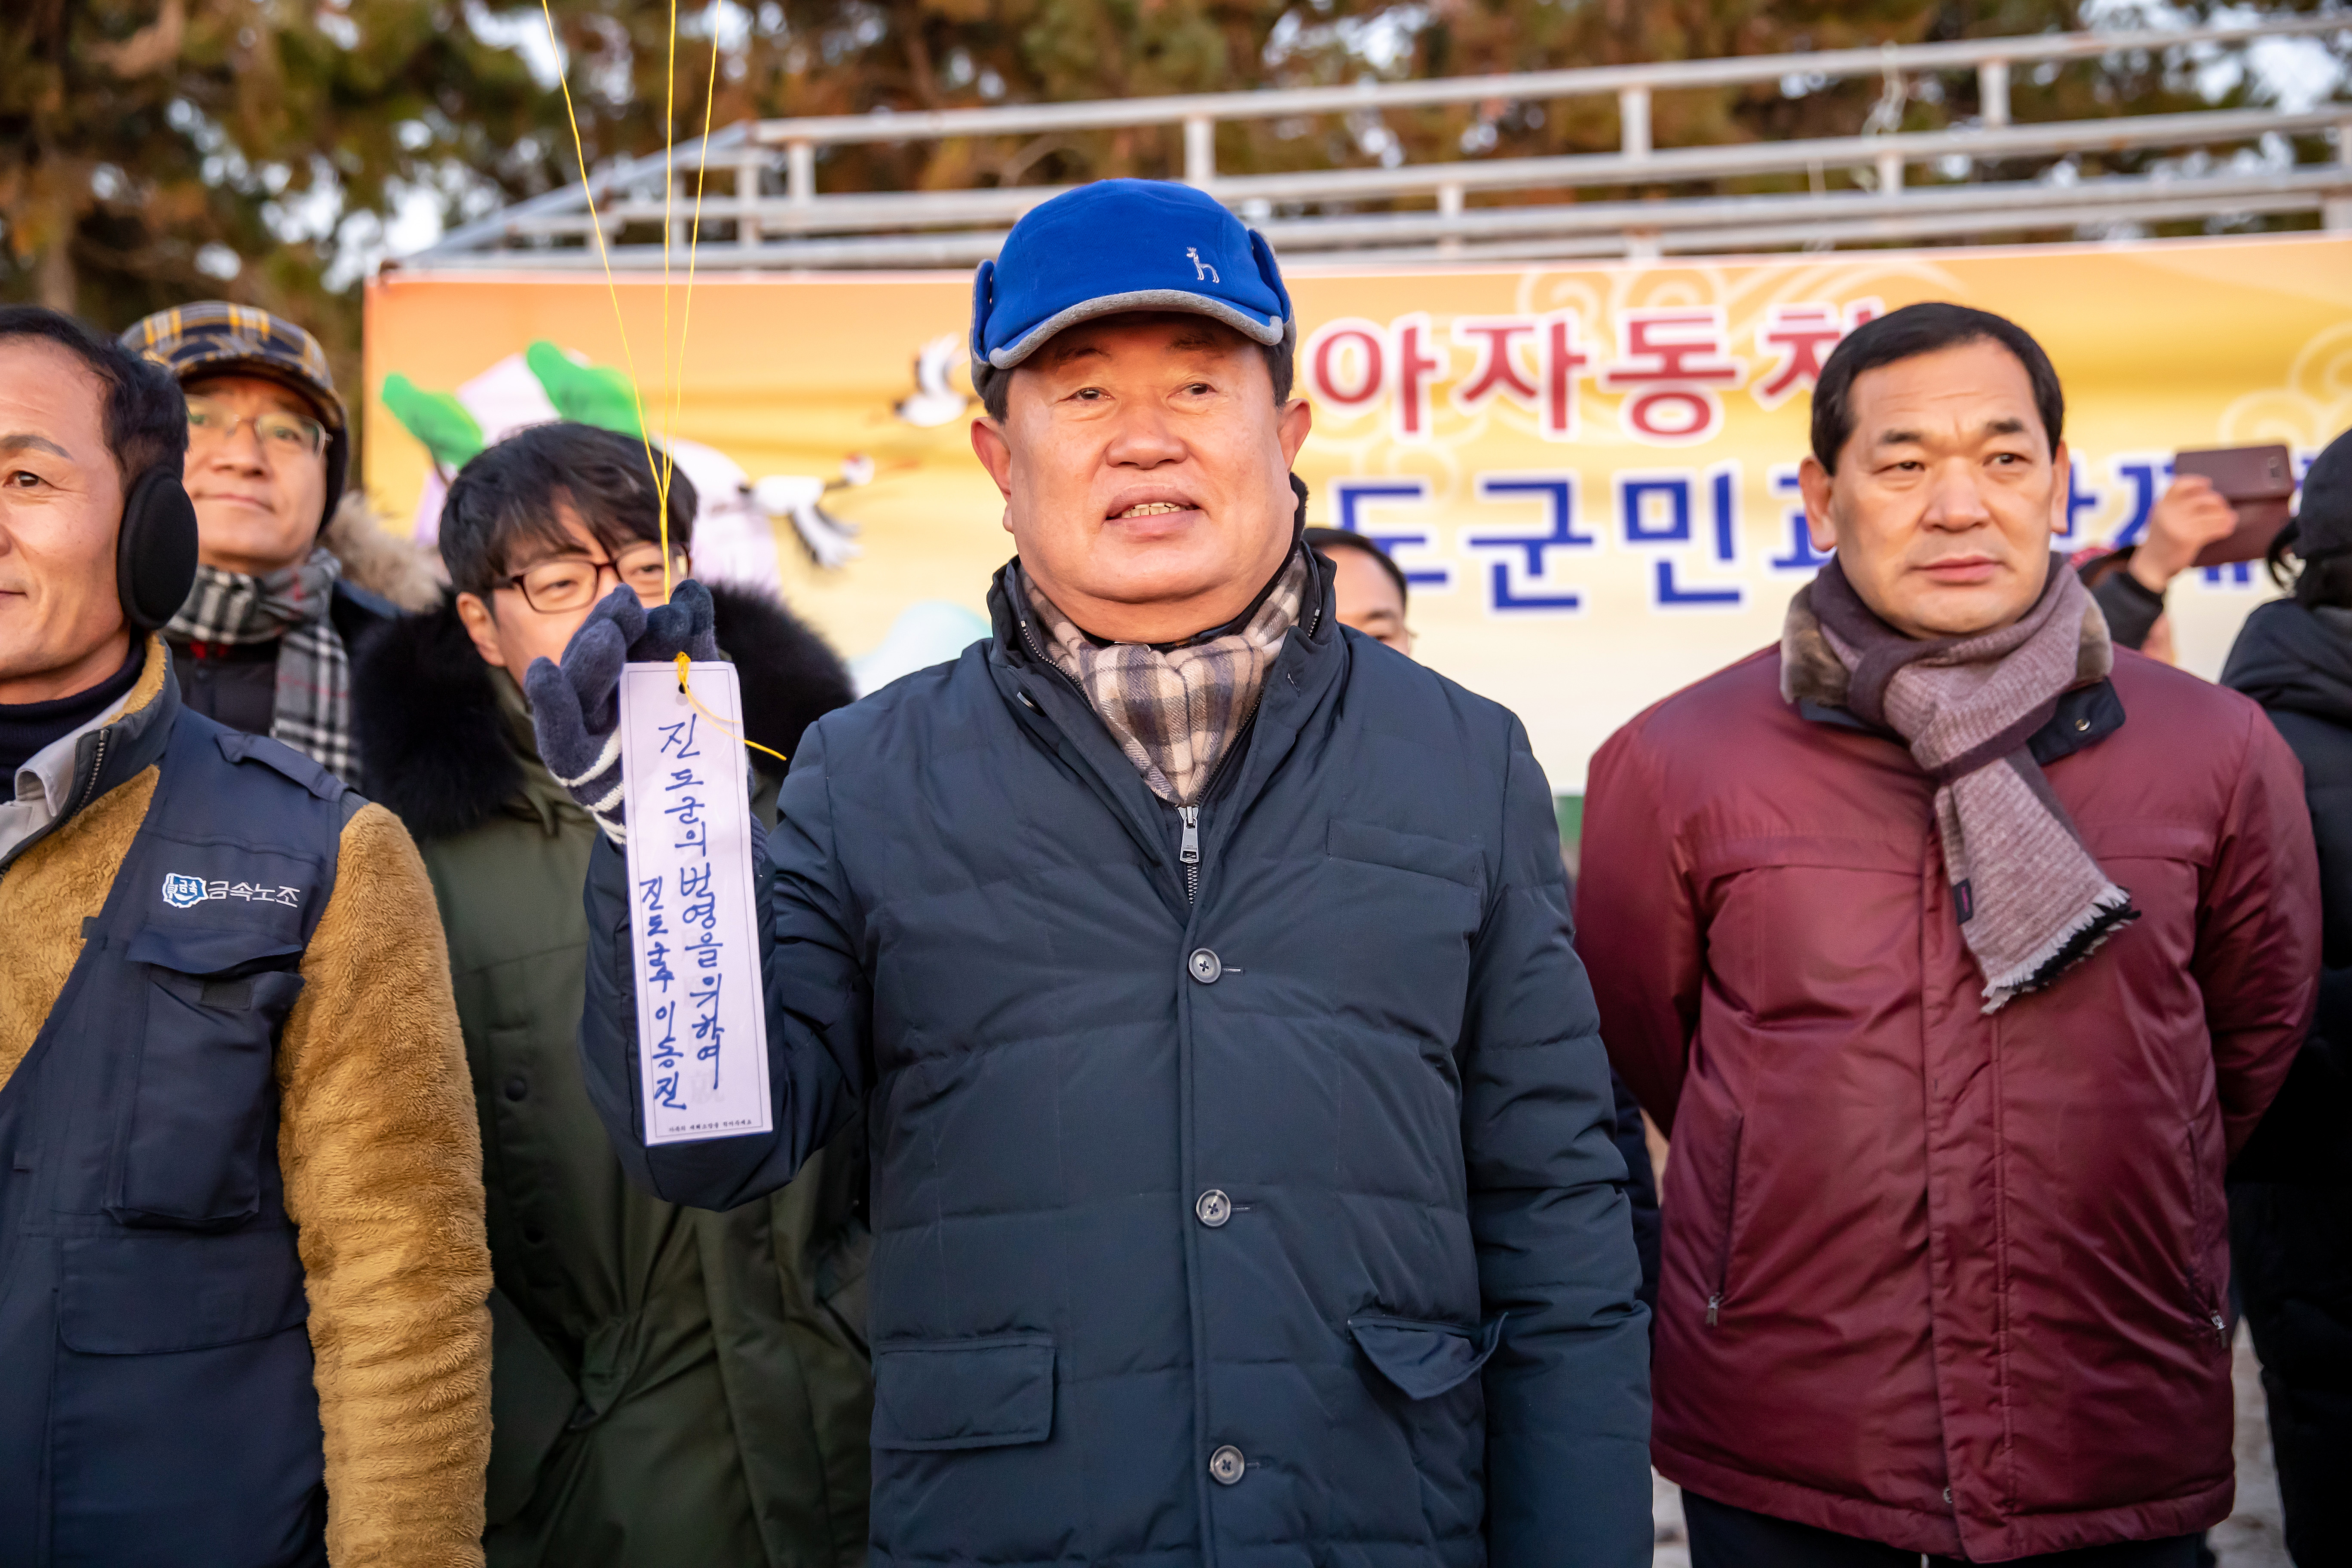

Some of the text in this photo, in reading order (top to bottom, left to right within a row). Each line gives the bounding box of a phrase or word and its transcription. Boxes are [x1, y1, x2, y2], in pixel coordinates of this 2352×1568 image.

[207, 880, 300, 908] 금속노조
[639, 875, 687, 1111] 진도군수 이동진
[658, 712, 725, 1090] 진도군의 번영을 위하여
